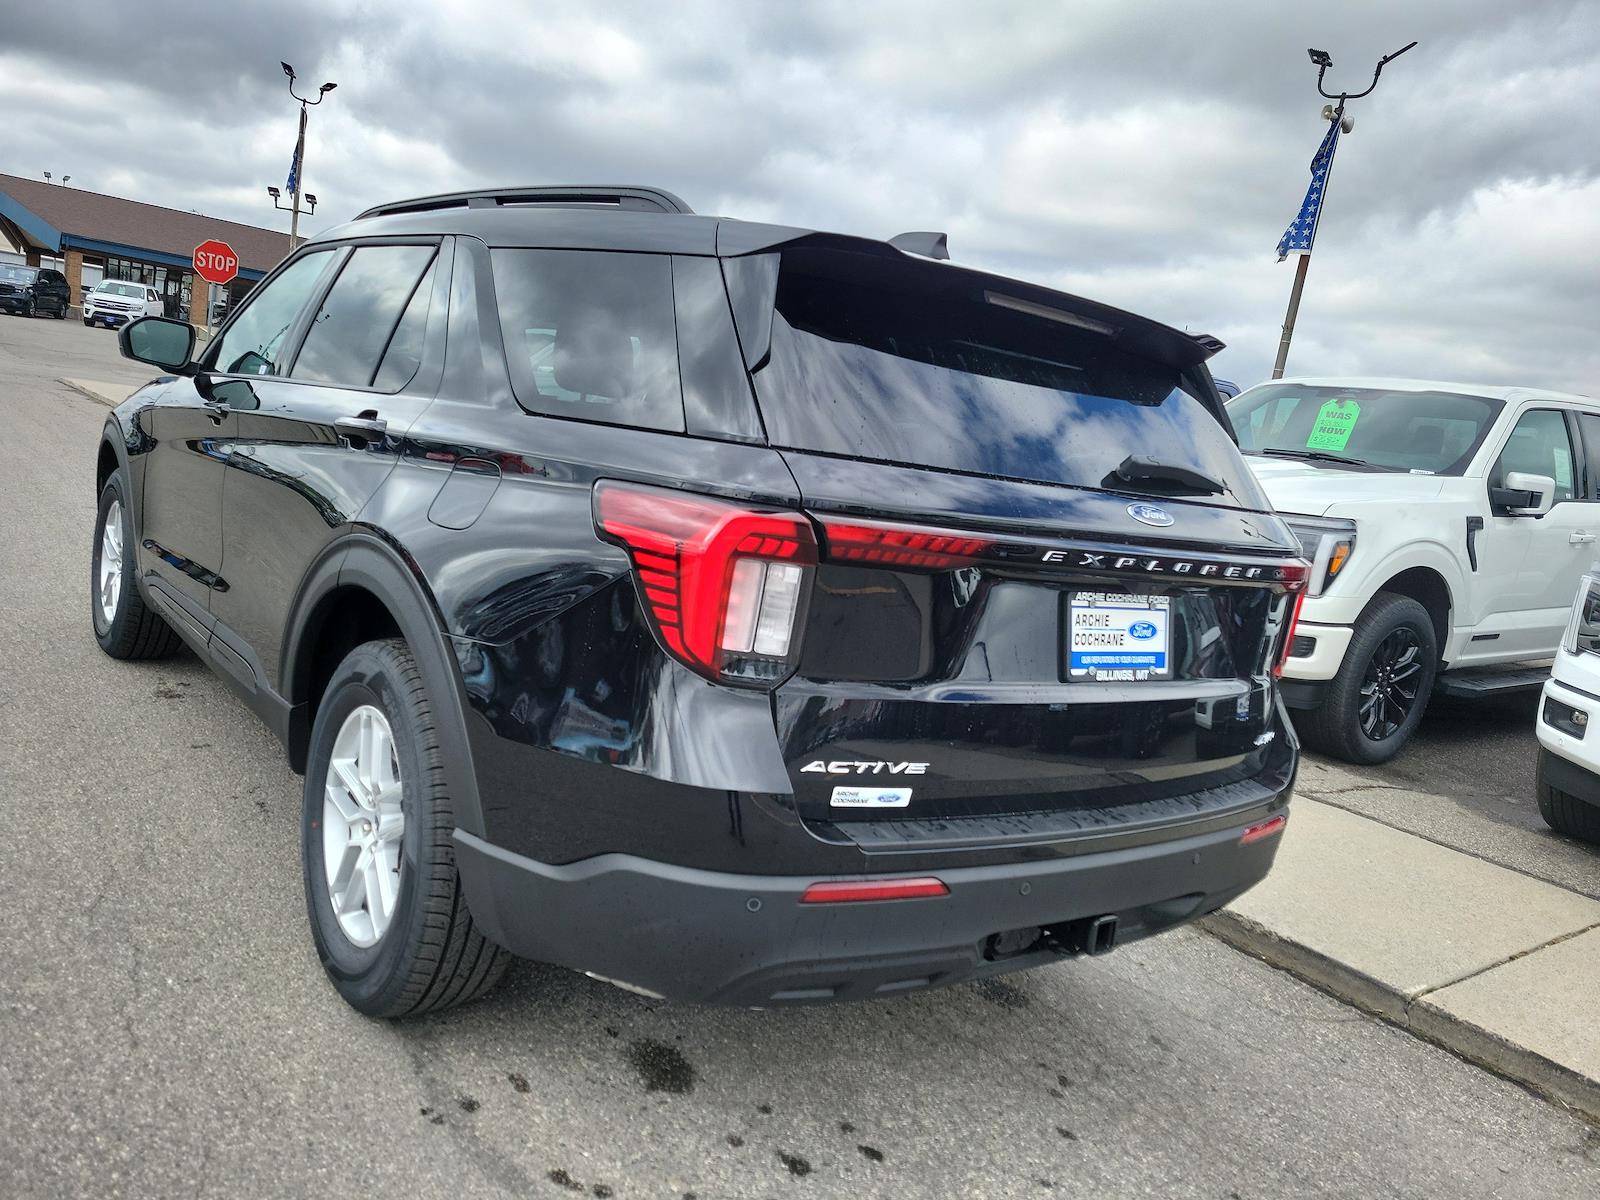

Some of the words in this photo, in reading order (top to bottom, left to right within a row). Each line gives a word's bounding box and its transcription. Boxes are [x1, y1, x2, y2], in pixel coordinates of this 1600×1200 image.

[196, 251, 236, 272] STOP
[1326, 410, 1353, 420] WAS
[1319, 426, 1347, 435] NOW
[1041, 550, 1262, 578] EXPLORER
[1075, 592, 1106, 601] ARCHIE
[1105, 593, 1148, 603] COCHRANE
[1148, 595, 1170, 604] FORD
[1075, 614, 1110, 627] ARCHIE
[1131, 621, 1154, 638] Ford
[1074, 633, 1124, 646] COCHRANE
[800, 760, 930, 775] ACTIVE
